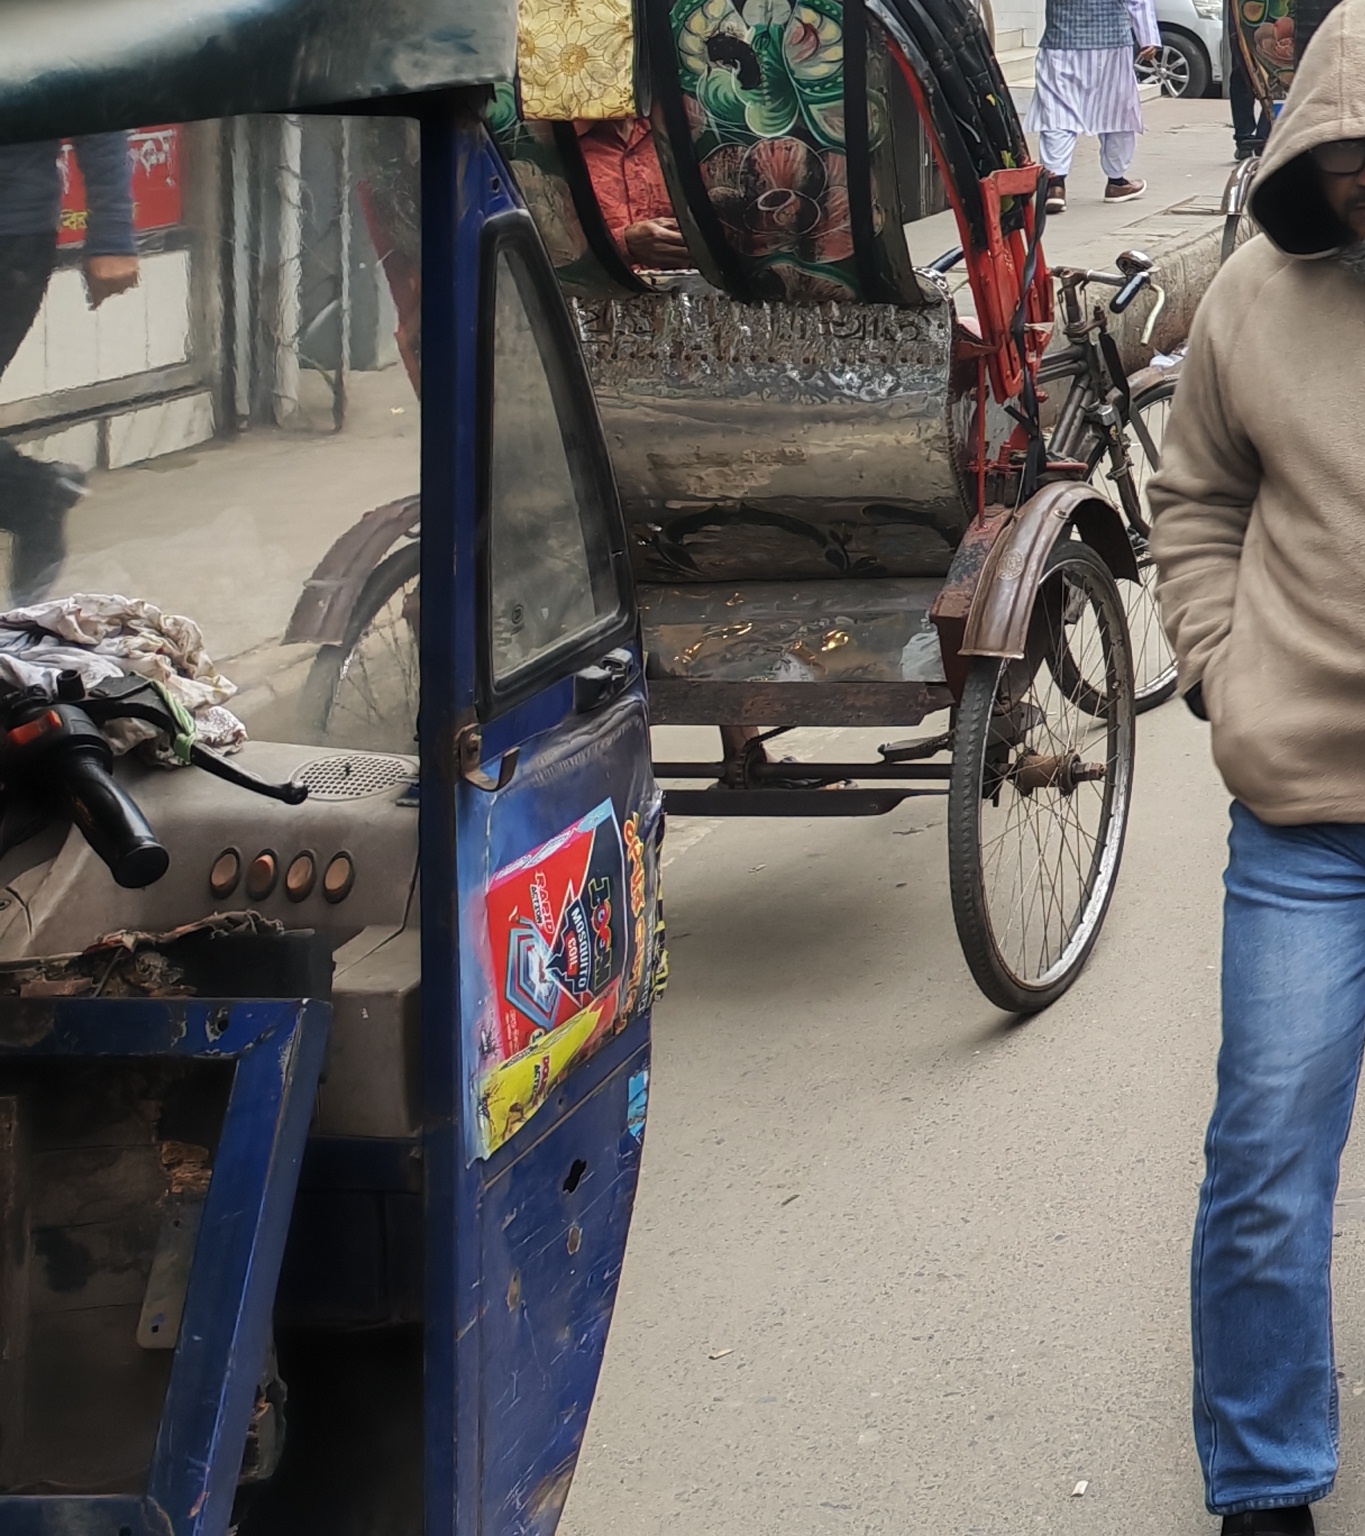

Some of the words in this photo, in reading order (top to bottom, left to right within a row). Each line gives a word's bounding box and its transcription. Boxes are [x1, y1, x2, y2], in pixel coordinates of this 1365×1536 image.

[530, 884, 543, 926] ACTION
[534, 871, 555, 934] RAPID
[566, 938, 578, 970] COIL
[571, 906, 587, 989] MOSQUITO
